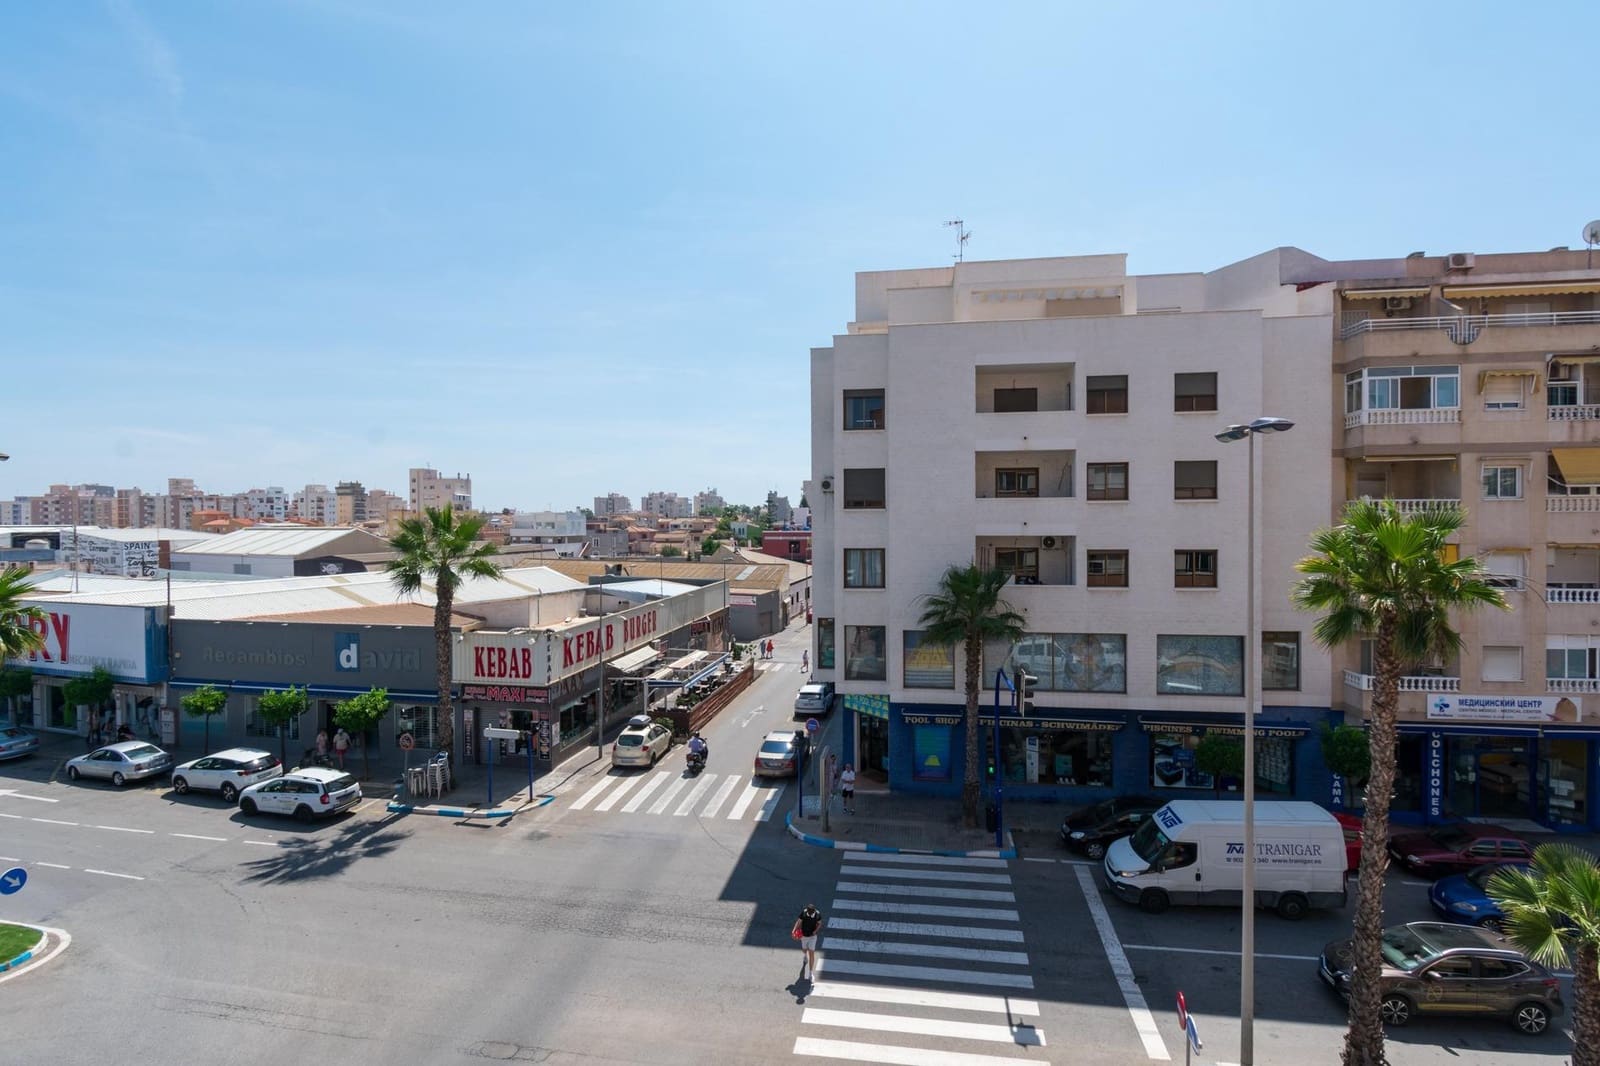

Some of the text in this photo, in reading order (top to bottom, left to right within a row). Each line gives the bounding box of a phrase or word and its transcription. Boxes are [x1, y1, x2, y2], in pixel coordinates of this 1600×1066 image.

[124, 542, 150, 550] SPAIN
[563, 610, 657, 669] KEBAB BURGER
[203, 643, 422, 671] Recambios david
[474, 646, 532, 678] KEBAB
[487, 686, 526, 702] MAXI
[1517, 700, 1542, 708] ЦЕНТР
[904, 716, 961, 725] POOL SHOP
[1143, 724, 1193, 733] PISCINES
[1207, 727, 1266, 736] SWIMMNG
[1256, 843, 1322, 856] TRANIGAR
